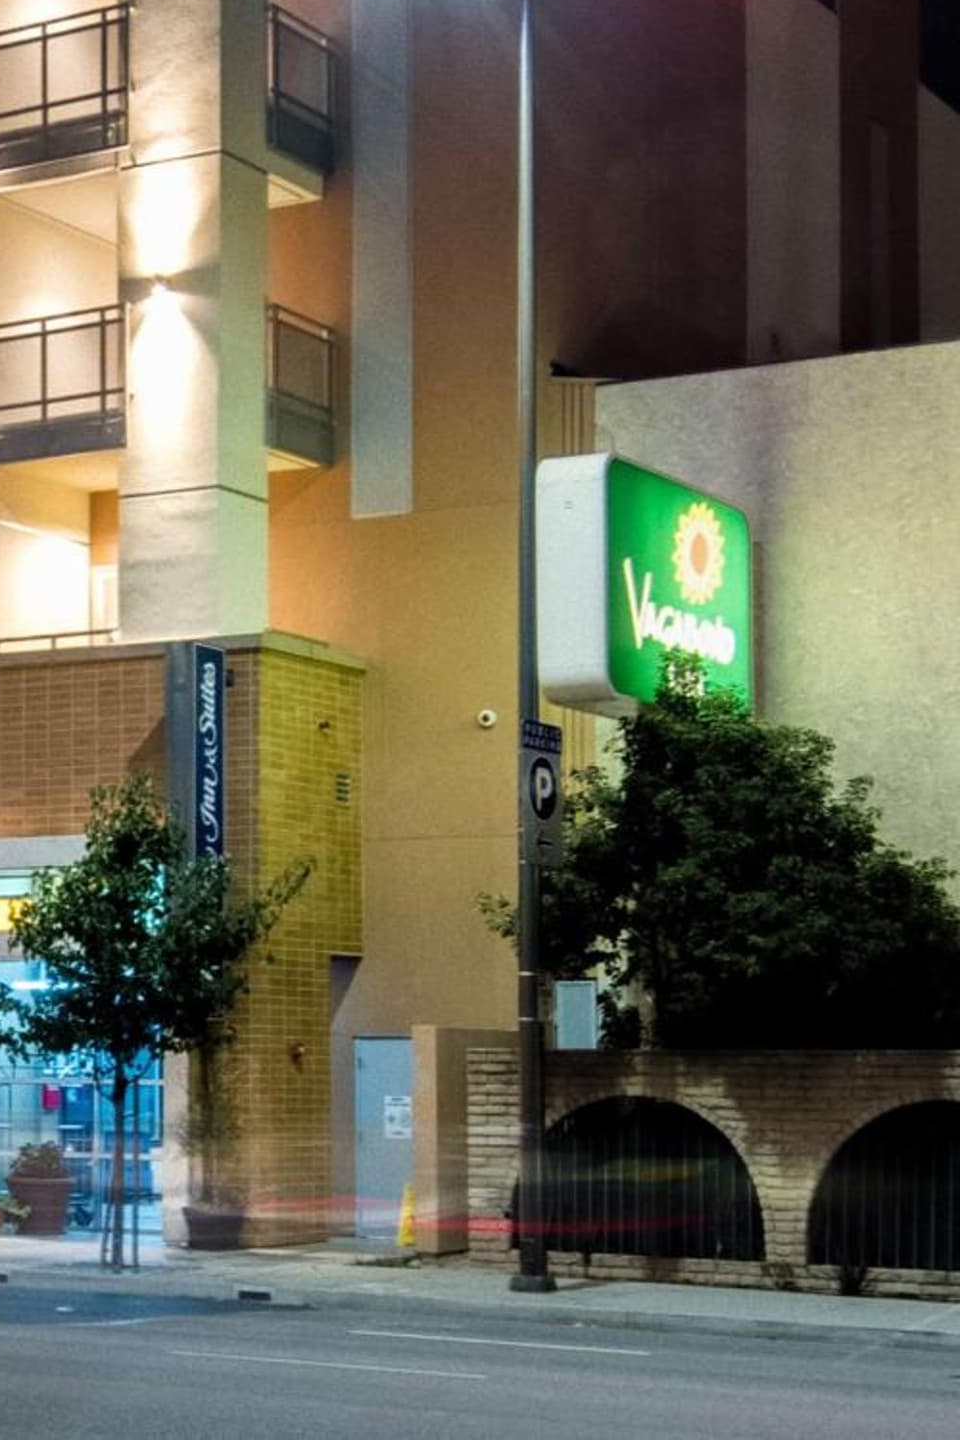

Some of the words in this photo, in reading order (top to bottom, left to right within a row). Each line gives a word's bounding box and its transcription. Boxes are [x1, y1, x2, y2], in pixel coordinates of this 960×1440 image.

[200, 662, 218, 747] Suites
[204, 744, 218, 764] &
[200, 764, 219, 843] Inn
[536, 766, 554, 811] P
